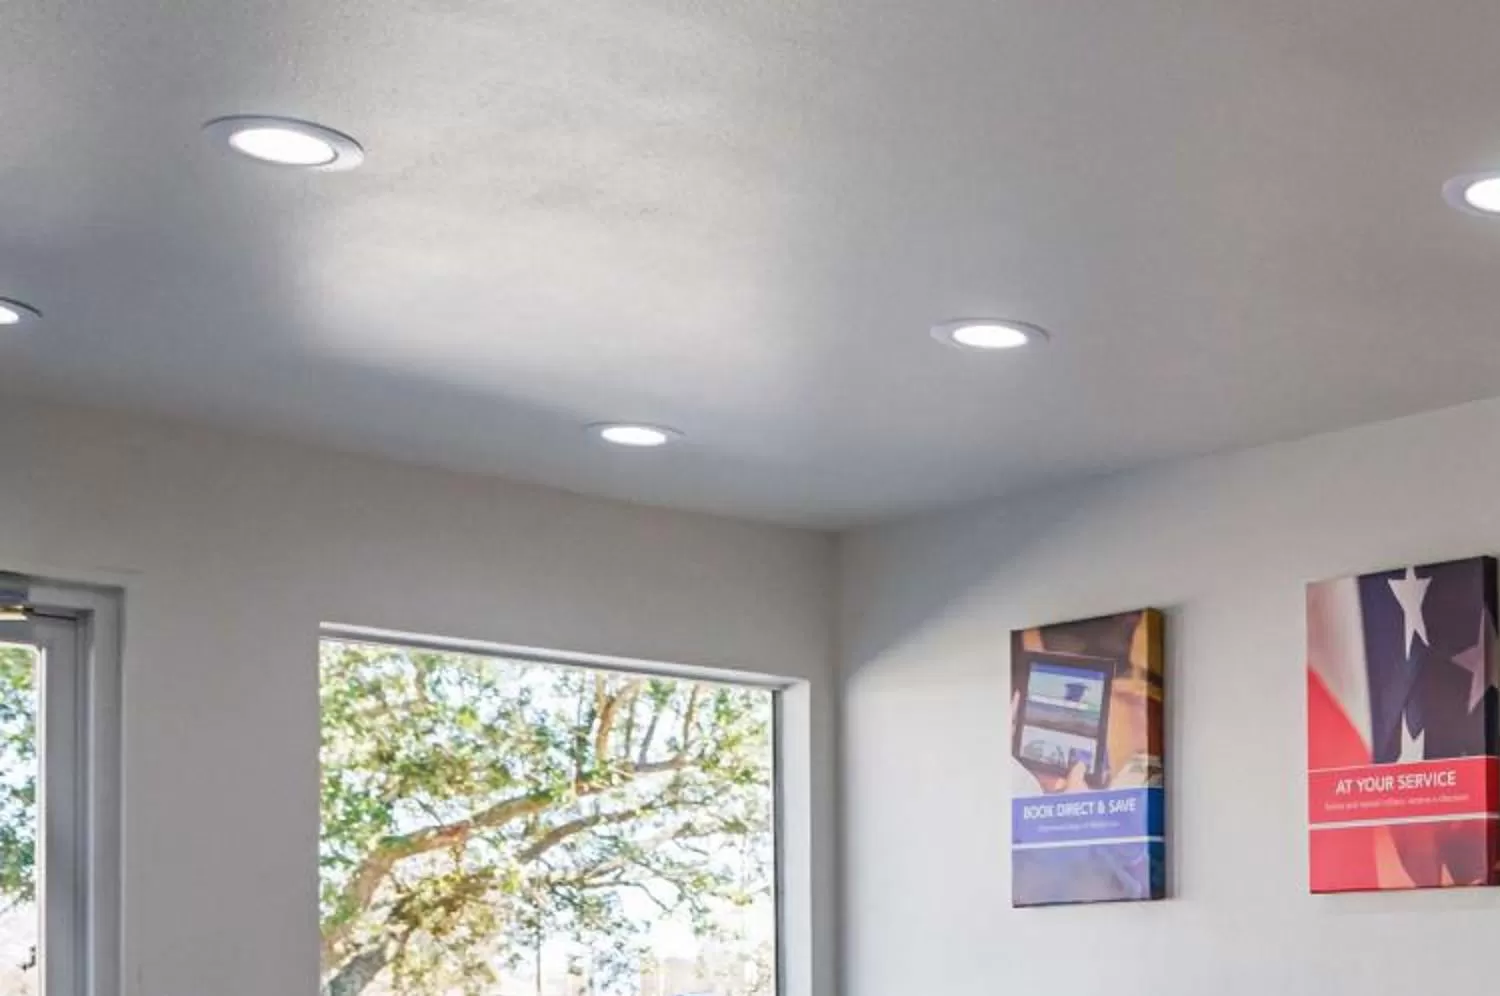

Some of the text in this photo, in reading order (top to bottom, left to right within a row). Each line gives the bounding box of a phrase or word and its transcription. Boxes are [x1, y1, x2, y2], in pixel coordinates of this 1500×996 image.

[1335, 770, 1456, 795] AT YOUR SERVICE
[1108, 798, 1137, 813] SAVE
